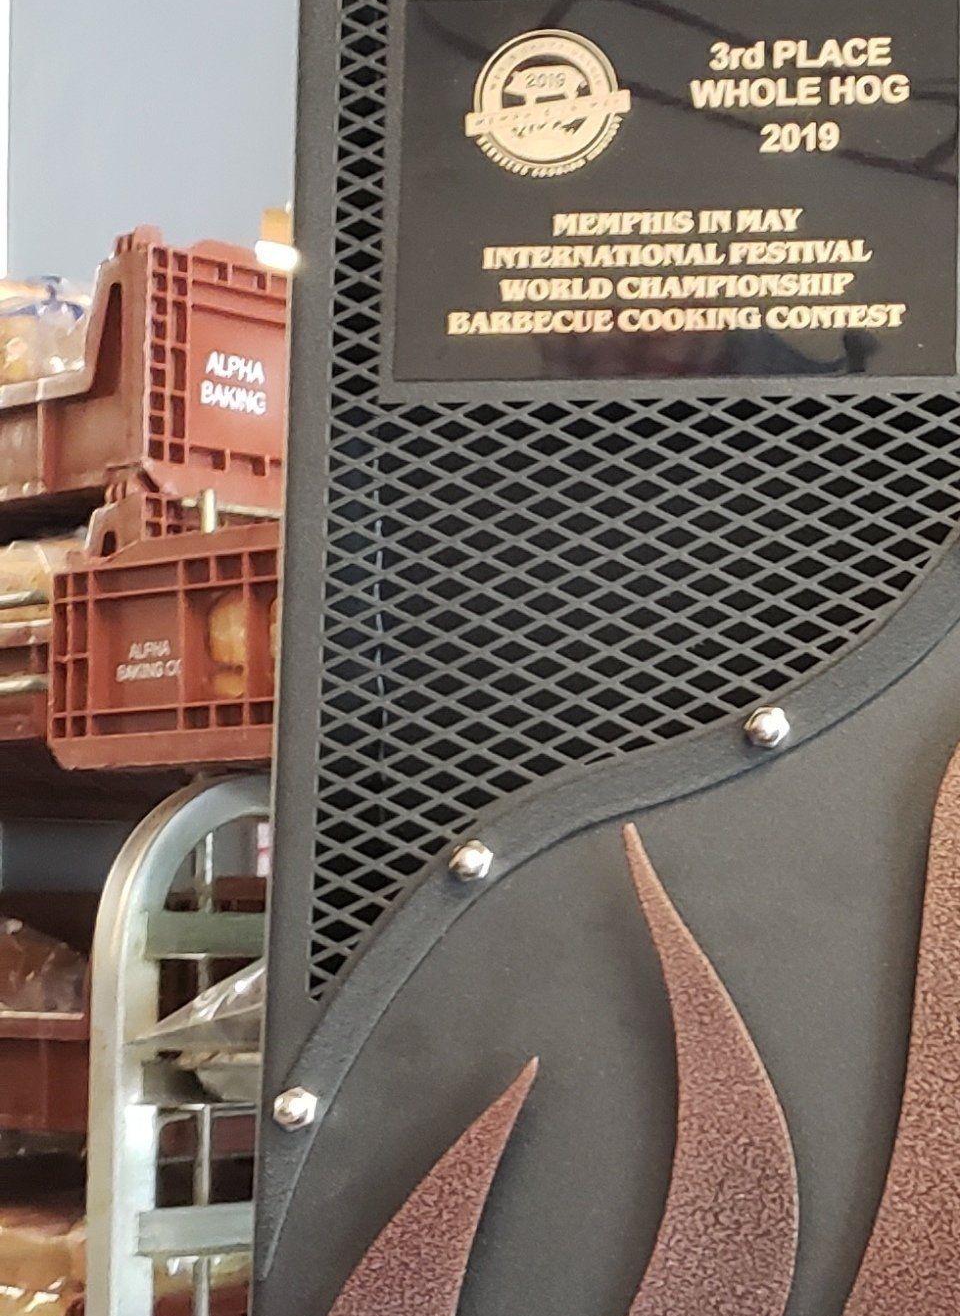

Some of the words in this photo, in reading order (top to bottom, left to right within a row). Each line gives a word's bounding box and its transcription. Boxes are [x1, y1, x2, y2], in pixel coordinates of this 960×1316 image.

[709, 41, 766, 71] 3rd
[772, 37, 893, 69] PLACE
[524, 72, 567, 88] 2019
[690, 76, 822, 109] WHOLE
[829, 74, 910, 105] HOG
[759, 121, 841, 153] 2019
[552, 210, 695, 237] MEMPHIS
[698, 209, 732, 234] IN
[736, 208, 804, 233] MAY
[482, 242, 726, 270] INTERNATIONAL
[728, 239, 873, 265] FESTIVAL
[499, 276, 614, 302] WORLD
[616, 272, 855, 301] CHAMPIONSHIP
[447, 308, 614, 335] BARBECUE
[616, 306, 762, 333] COOKING
[765, 303, 907, 330] CONTEST
[205, 350, 266, 385] ALPHA
[200, 379, 267, 416] BAKING
[128, 639, 171, 660] ALPHA
